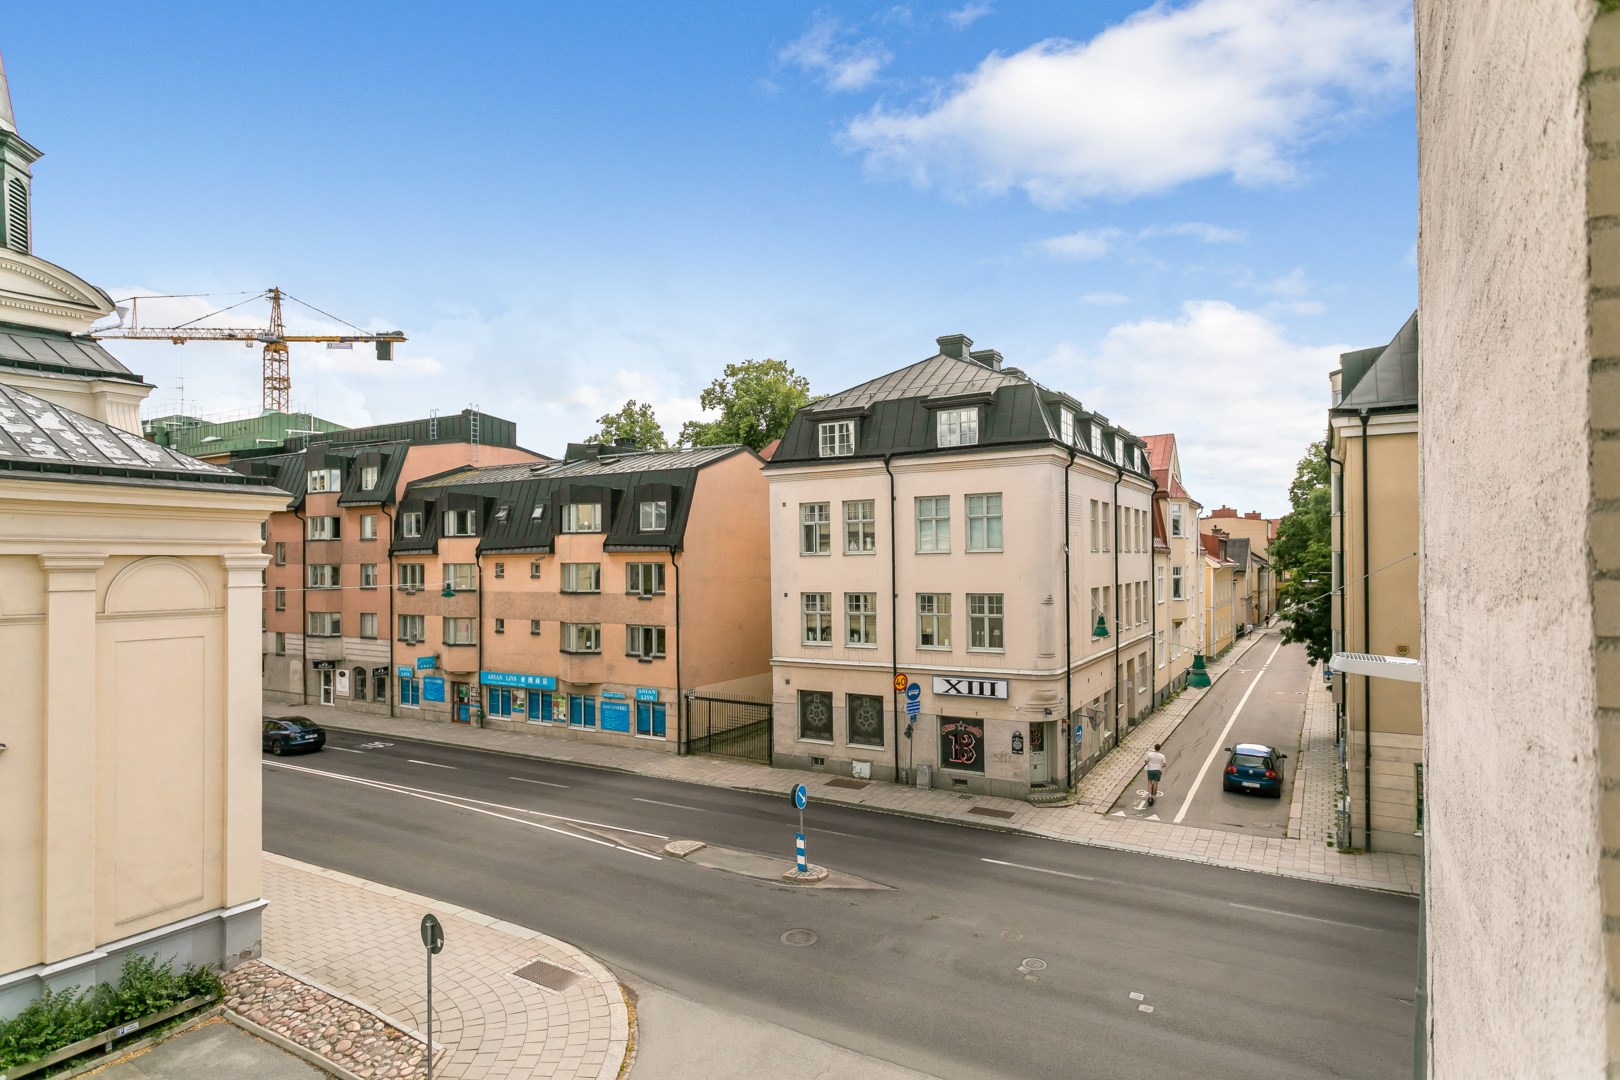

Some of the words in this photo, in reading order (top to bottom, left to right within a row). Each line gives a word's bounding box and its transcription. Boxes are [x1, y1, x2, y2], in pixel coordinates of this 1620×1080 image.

[488, 673, 503, 681] ASIAN
[896, 677, 906, 687] 40
[942, 678, 998, 696] XIII
